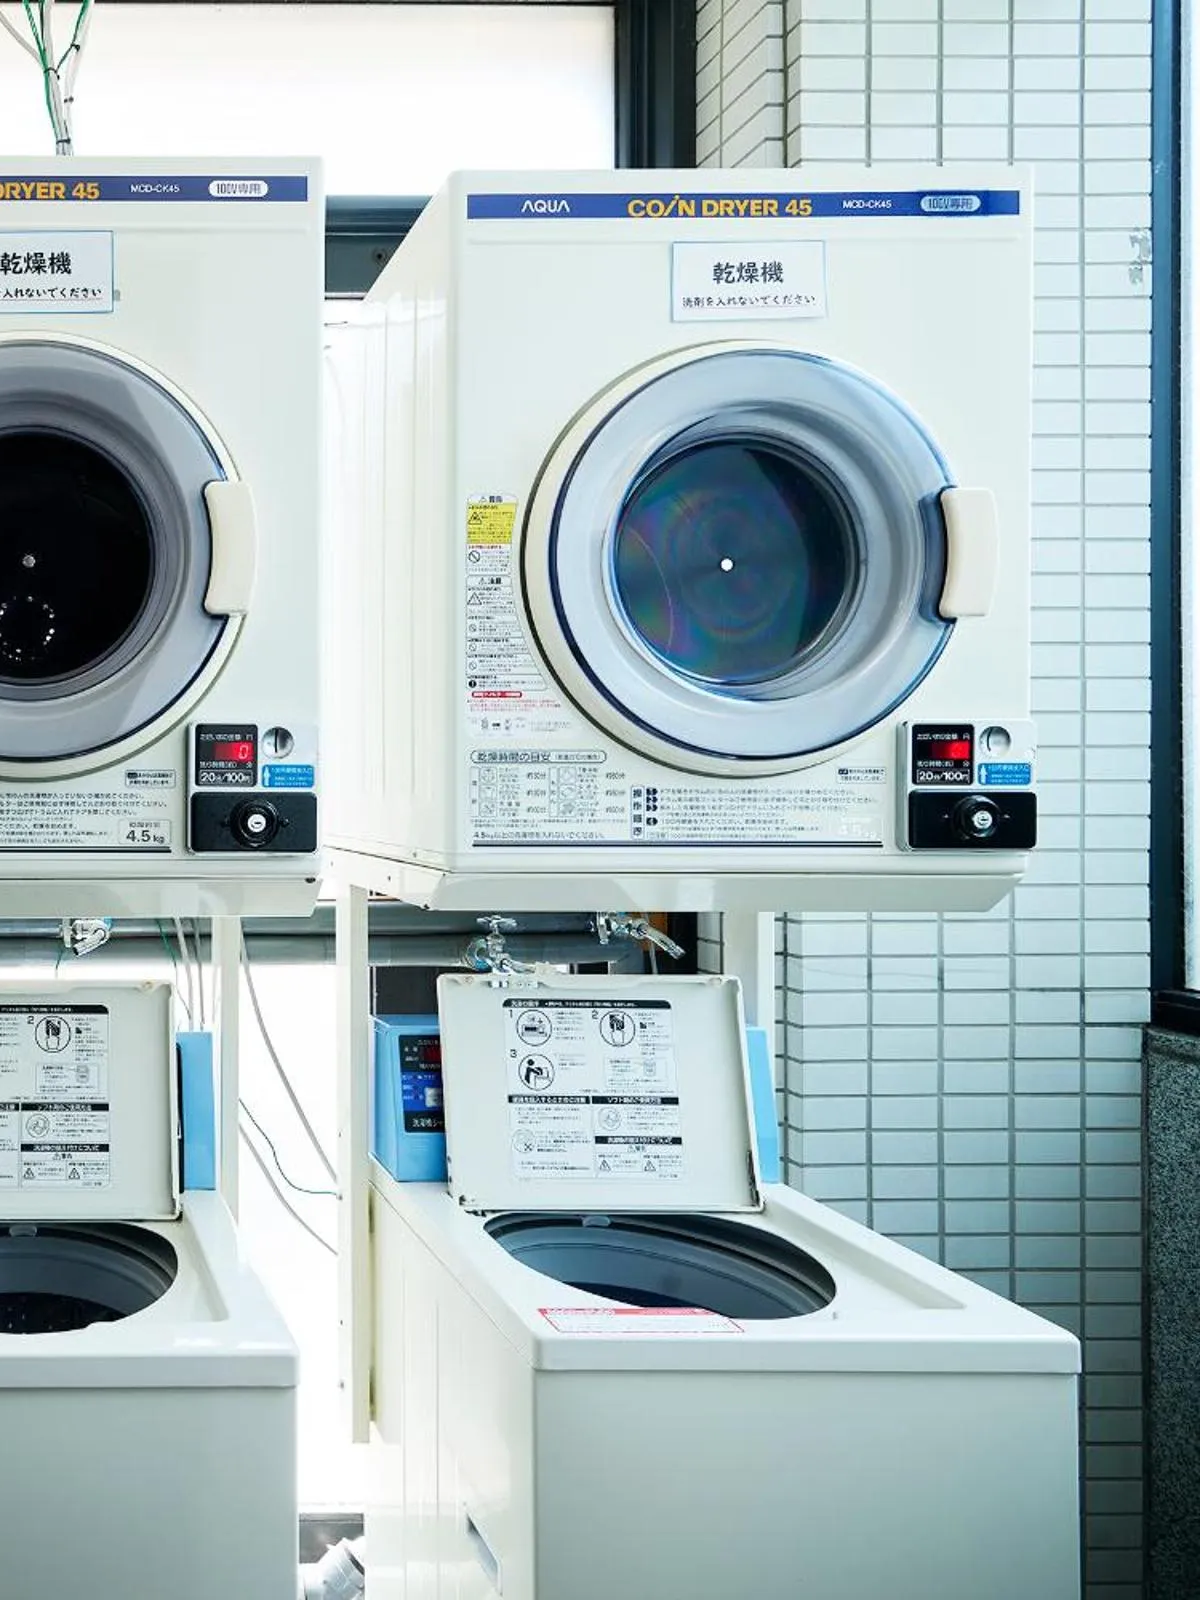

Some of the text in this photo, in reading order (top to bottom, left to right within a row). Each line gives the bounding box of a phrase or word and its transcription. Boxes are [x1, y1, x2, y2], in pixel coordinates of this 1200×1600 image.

[72, 182, 100, 200] 45
[130, 183, 180, 193] MCD-CK45
[521, 199, 570, 213] AQUA
[702, 199, 778, 217] DRYER
[785, 199, 812, 217] 45
[843, 199, 892, 209] MCD-CK45
[0, 252, 72, 275] 乾燥機
[712, 261, 784, 284] 乾燥機
[682, 295, 816, 308] 洗剤を入れないでください
